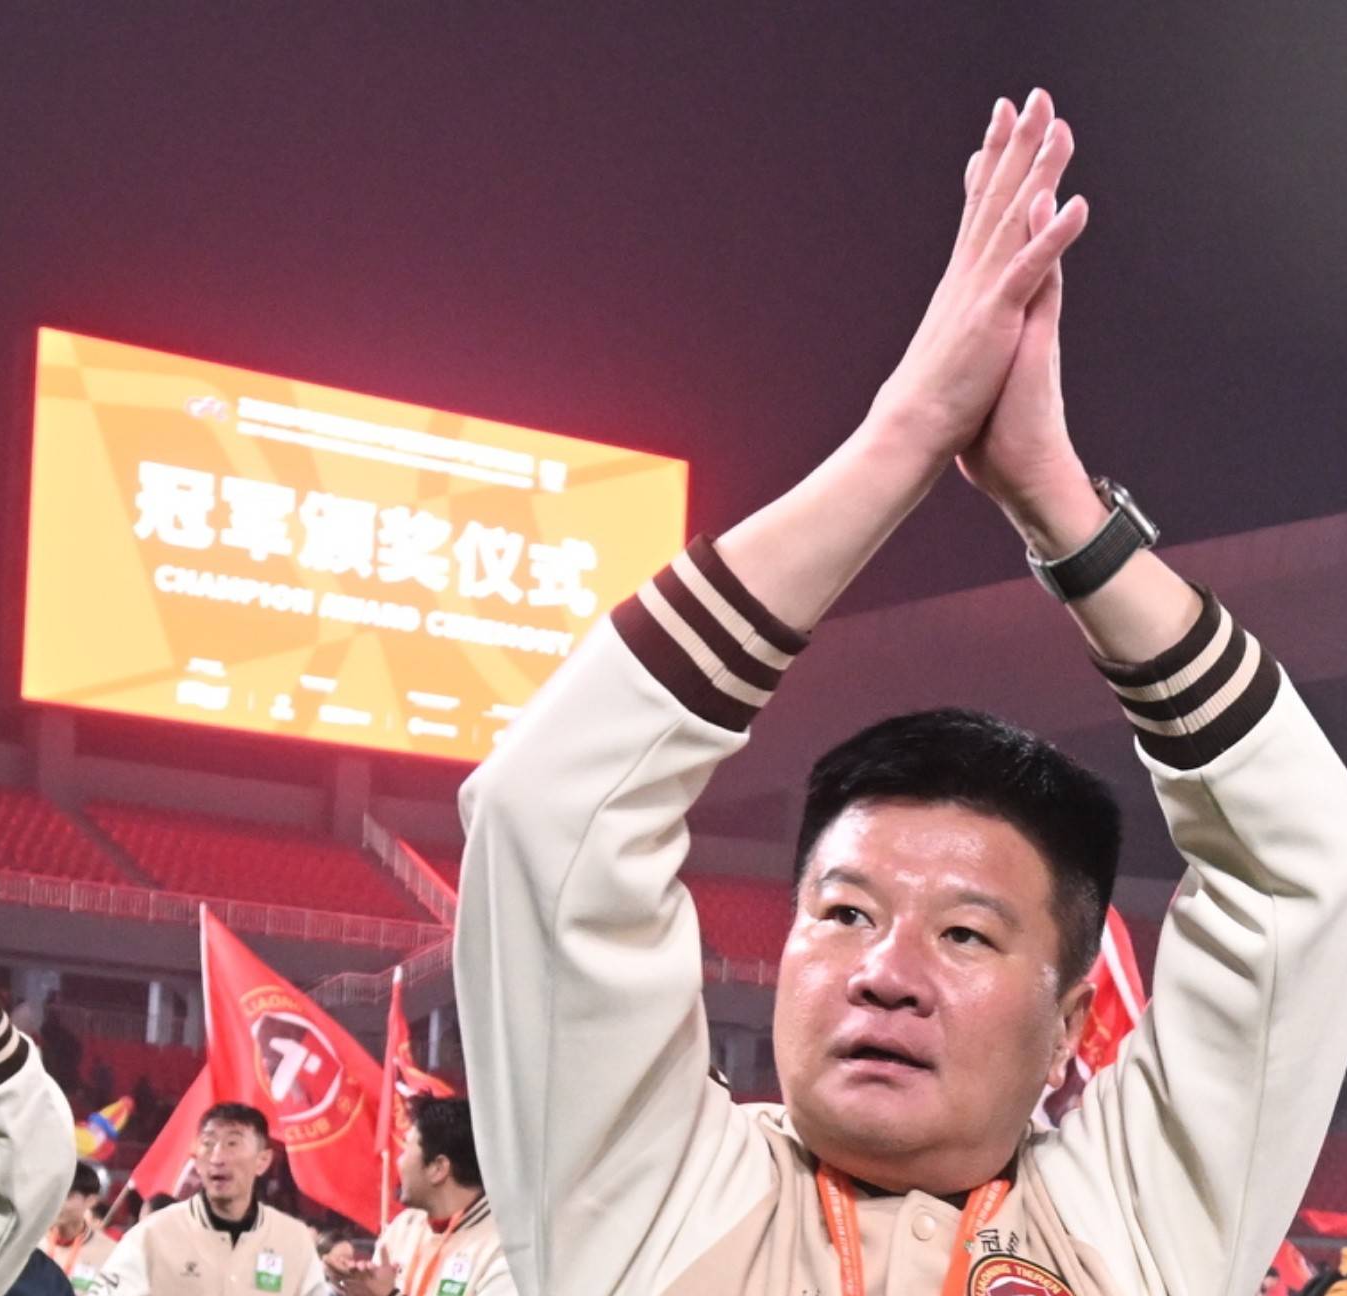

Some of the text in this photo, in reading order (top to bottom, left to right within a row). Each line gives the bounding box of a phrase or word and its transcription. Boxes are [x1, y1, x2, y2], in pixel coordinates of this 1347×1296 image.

[133, 460, 598, 617] 冠军颁奖仪式
[154, 564, 314, 616] CHAMPION
